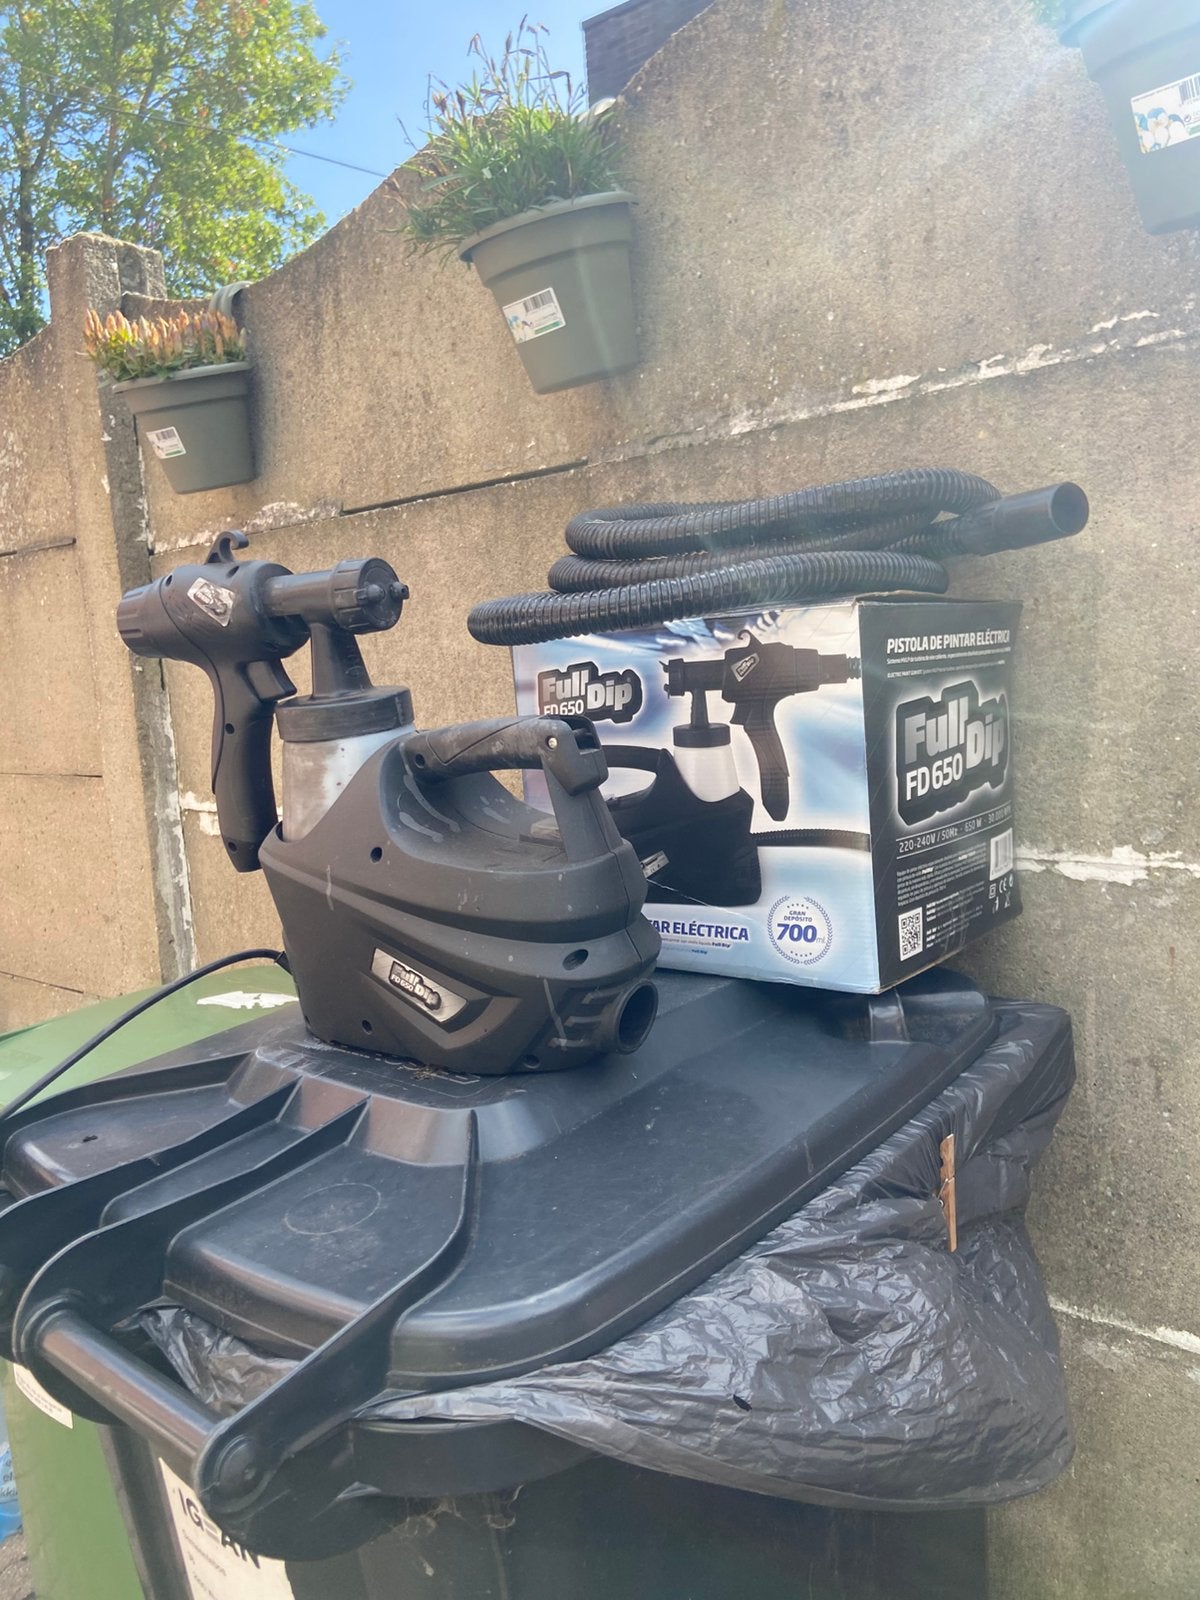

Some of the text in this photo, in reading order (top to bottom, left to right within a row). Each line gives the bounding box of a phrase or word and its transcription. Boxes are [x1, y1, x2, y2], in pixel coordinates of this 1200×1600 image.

[887, 628, 1011, 654] PISTOLA DE PINTAR ELÉCTRICA
[542, 669, 633, 711] Full Dip
[559, 699, 584, 716] 650
[905, 695, 1005, 770] Full Dip
[906, 752, 964, 801] FD 650
[899, 834, 936, 854] 220-240V
[941, 828, 959, 841] 50Hz
[964, 819, 976, 833] 650
[648, 920, 749, 942] AR ELÉCTRICA
[783, 914, 813, 923] DEPÓSITO
[776, 923, 818, 944] 700
[391, 974, 414, 992] FD 650
[391, 964, 439, 1006] Full Dip
